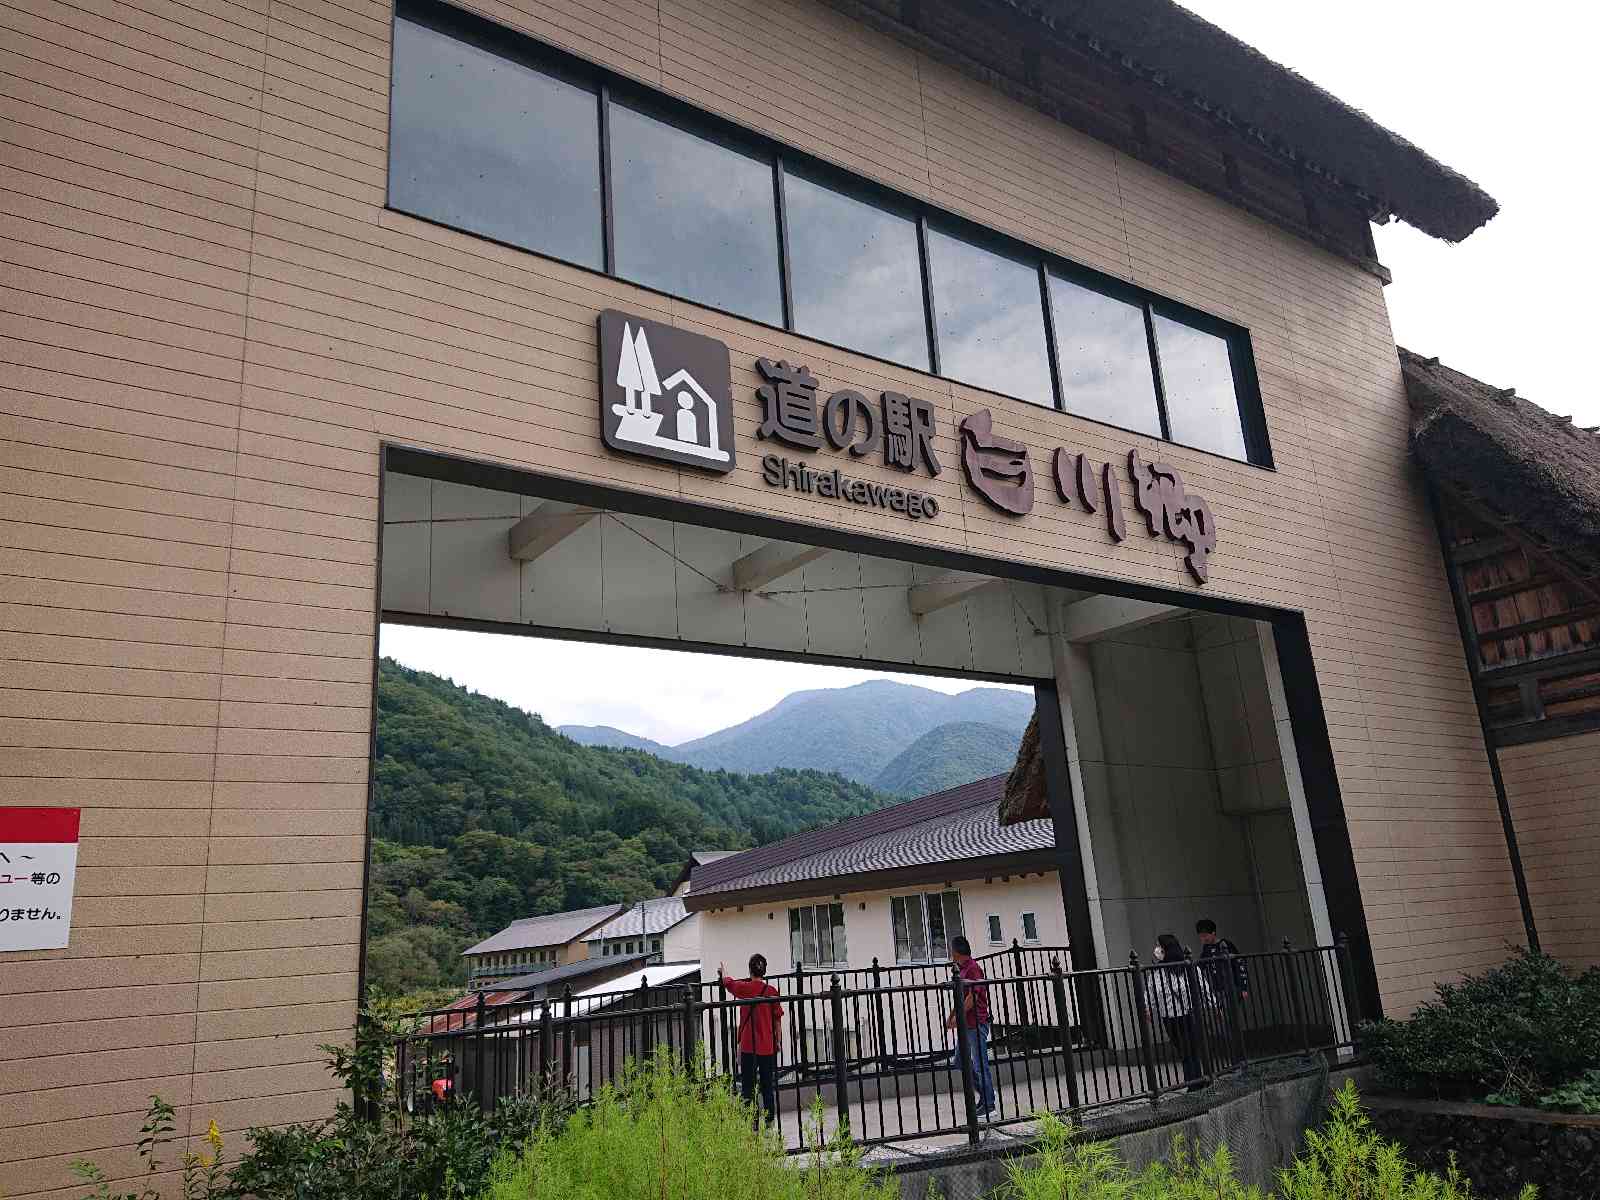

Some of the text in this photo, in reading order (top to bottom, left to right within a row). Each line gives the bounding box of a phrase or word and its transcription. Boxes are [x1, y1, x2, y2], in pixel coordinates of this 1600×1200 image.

[755, 357, 942, 477] 道の駅
[763, 453, 939, 518] Shirakawago
